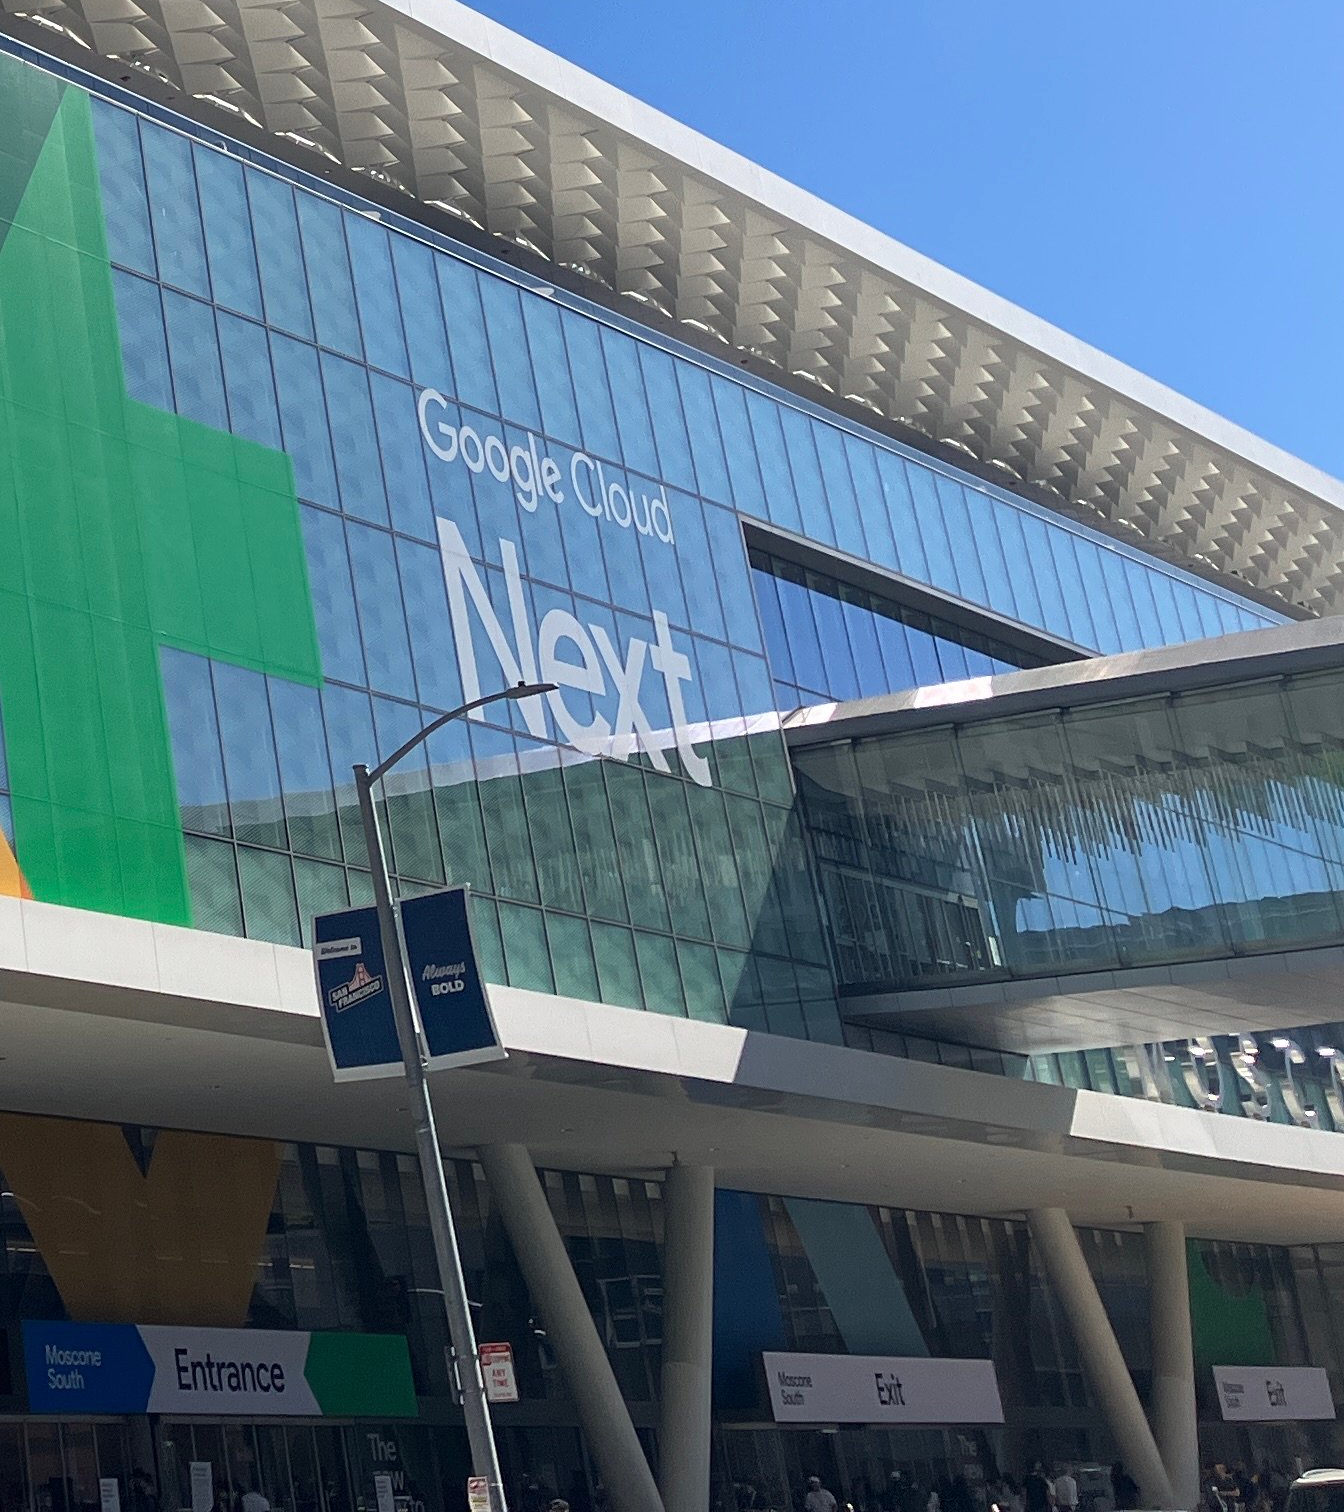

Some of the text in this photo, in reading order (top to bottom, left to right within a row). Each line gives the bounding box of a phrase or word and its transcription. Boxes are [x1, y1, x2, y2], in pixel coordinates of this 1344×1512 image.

[418, 387, 675, 545] Google Cloud
[436, 516, 712, 787] Next
[422, 961, 466, 981] Always
[332, 985, 349, 1002] SAN
[338, 980, 380, 1009] FRANCISCO
[431, 980, 465, 996] BOLD
[45, 1344, 102, 1367] Moscone
[48, 1367, 84, 1390] South
[175, 1348, 285, 1394] Entrance
[778, 1372, 812, 1388] Moscone
[781, 1389, 805, 1405] South
[875, 1373, 906, 1406] Exit
[366, 1433, 397, 1461] The
